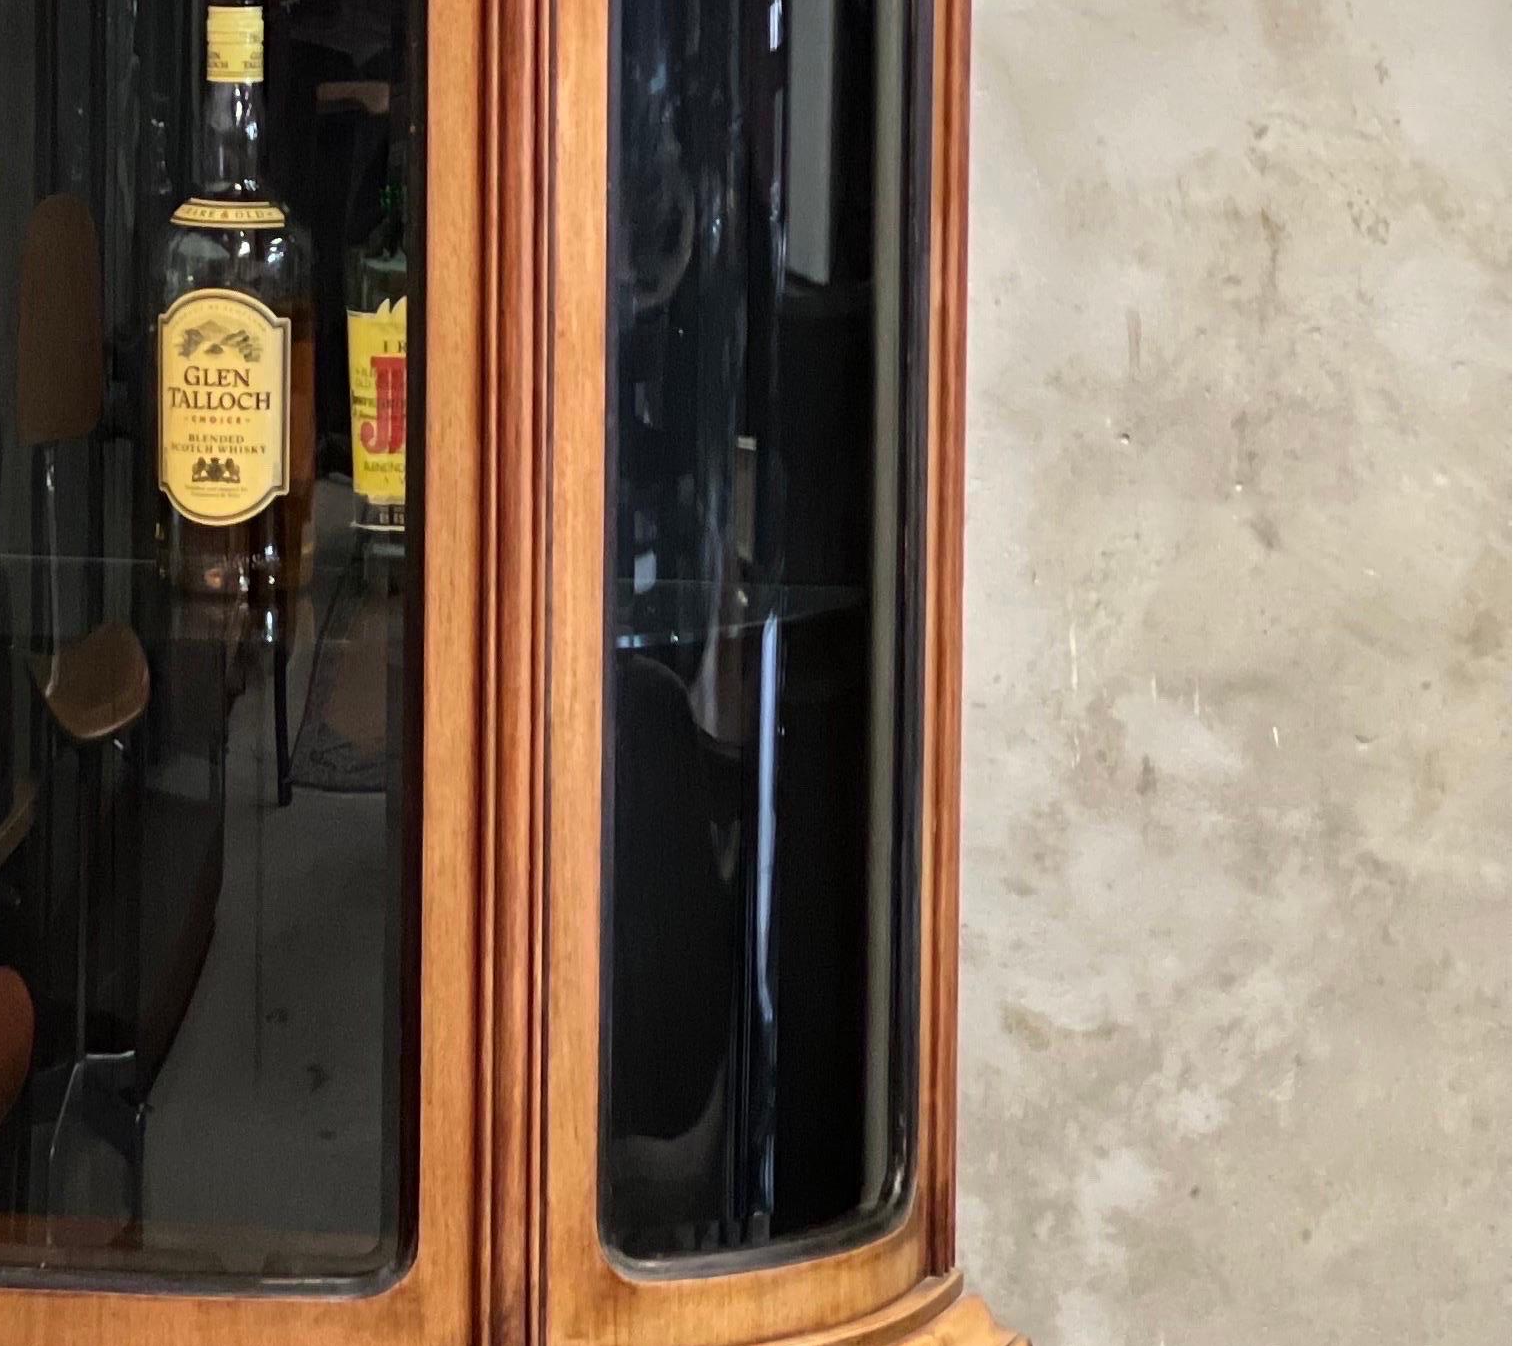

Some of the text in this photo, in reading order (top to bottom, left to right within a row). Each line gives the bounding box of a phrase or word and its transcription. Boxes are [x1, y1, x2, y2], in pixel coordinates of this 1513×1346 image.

[235, 210, 264, 219] OLD
[184, 365, 250, 388] GLEN
[168, 387, 271, 410] TALLOCH
[188, 433, 244, 444] BLENDED
[171, 442, 266, 455] SCOTCH WHISKY
